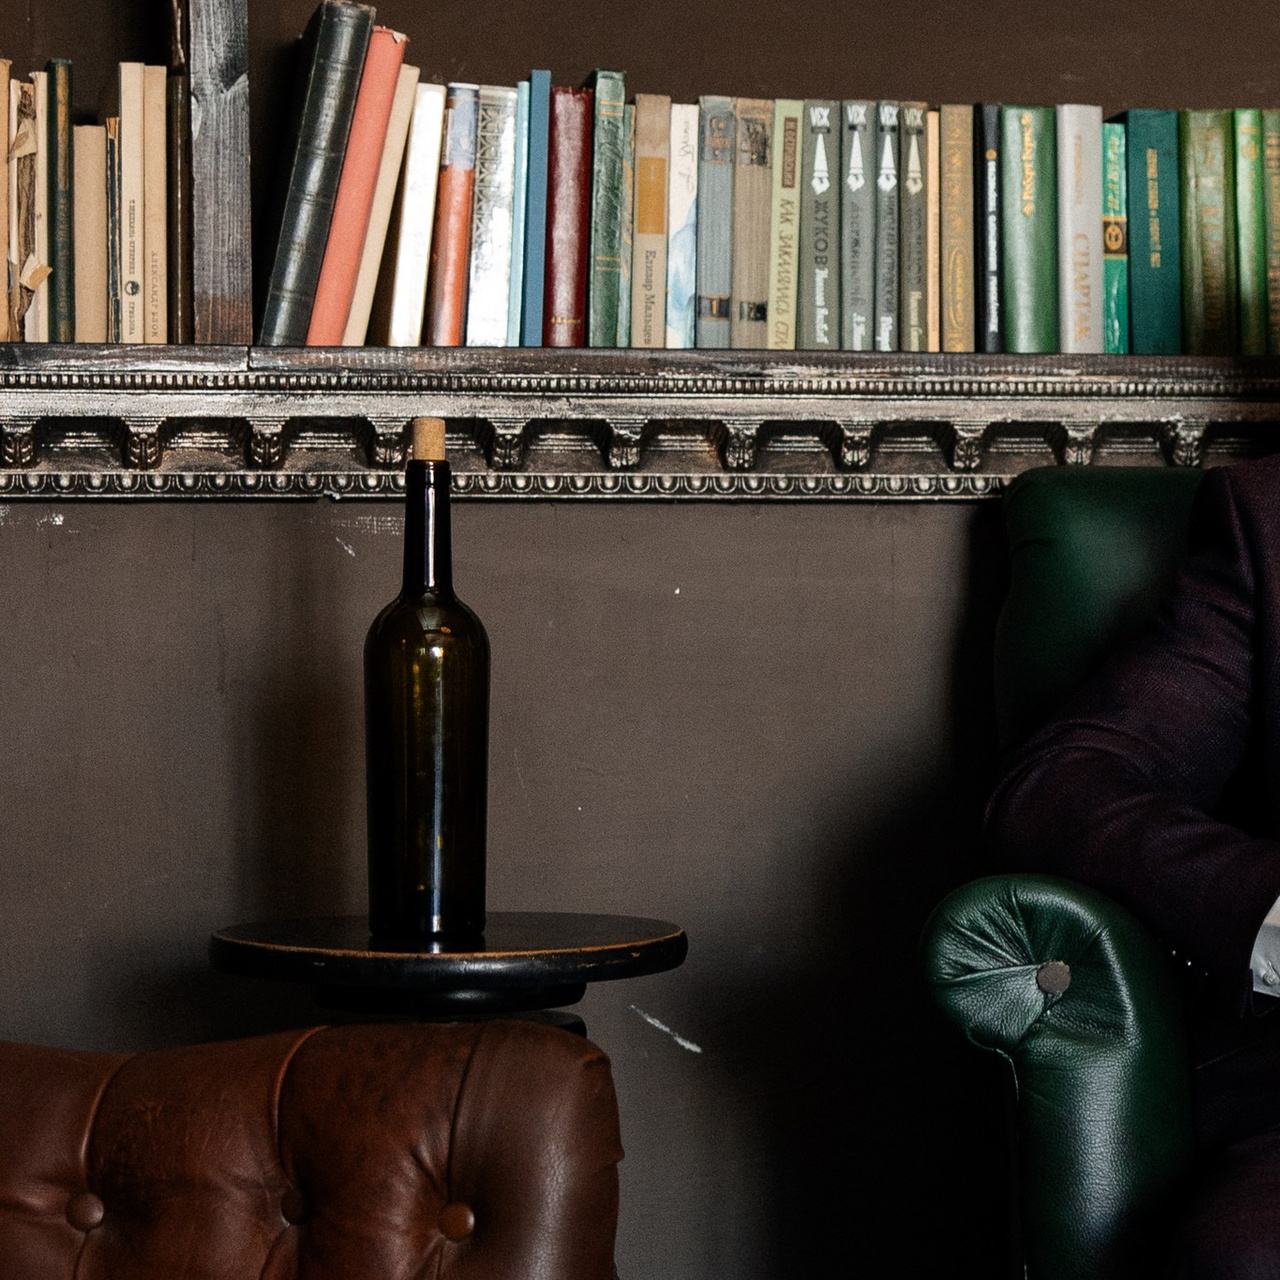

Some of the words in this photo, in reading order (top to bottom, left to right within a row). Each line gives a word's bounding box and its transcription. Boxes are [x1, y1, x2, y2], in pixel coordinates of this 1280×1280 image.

[779, 198, 794, 225] КАК
[813, 198, 828, 266] ЖУКОВ
[776, 228, 793, 315] ЗАКАЛЯЛАСЬ
[151, 311, 159, 338] БЛОК
[774, 320, 790, 346] СТА
